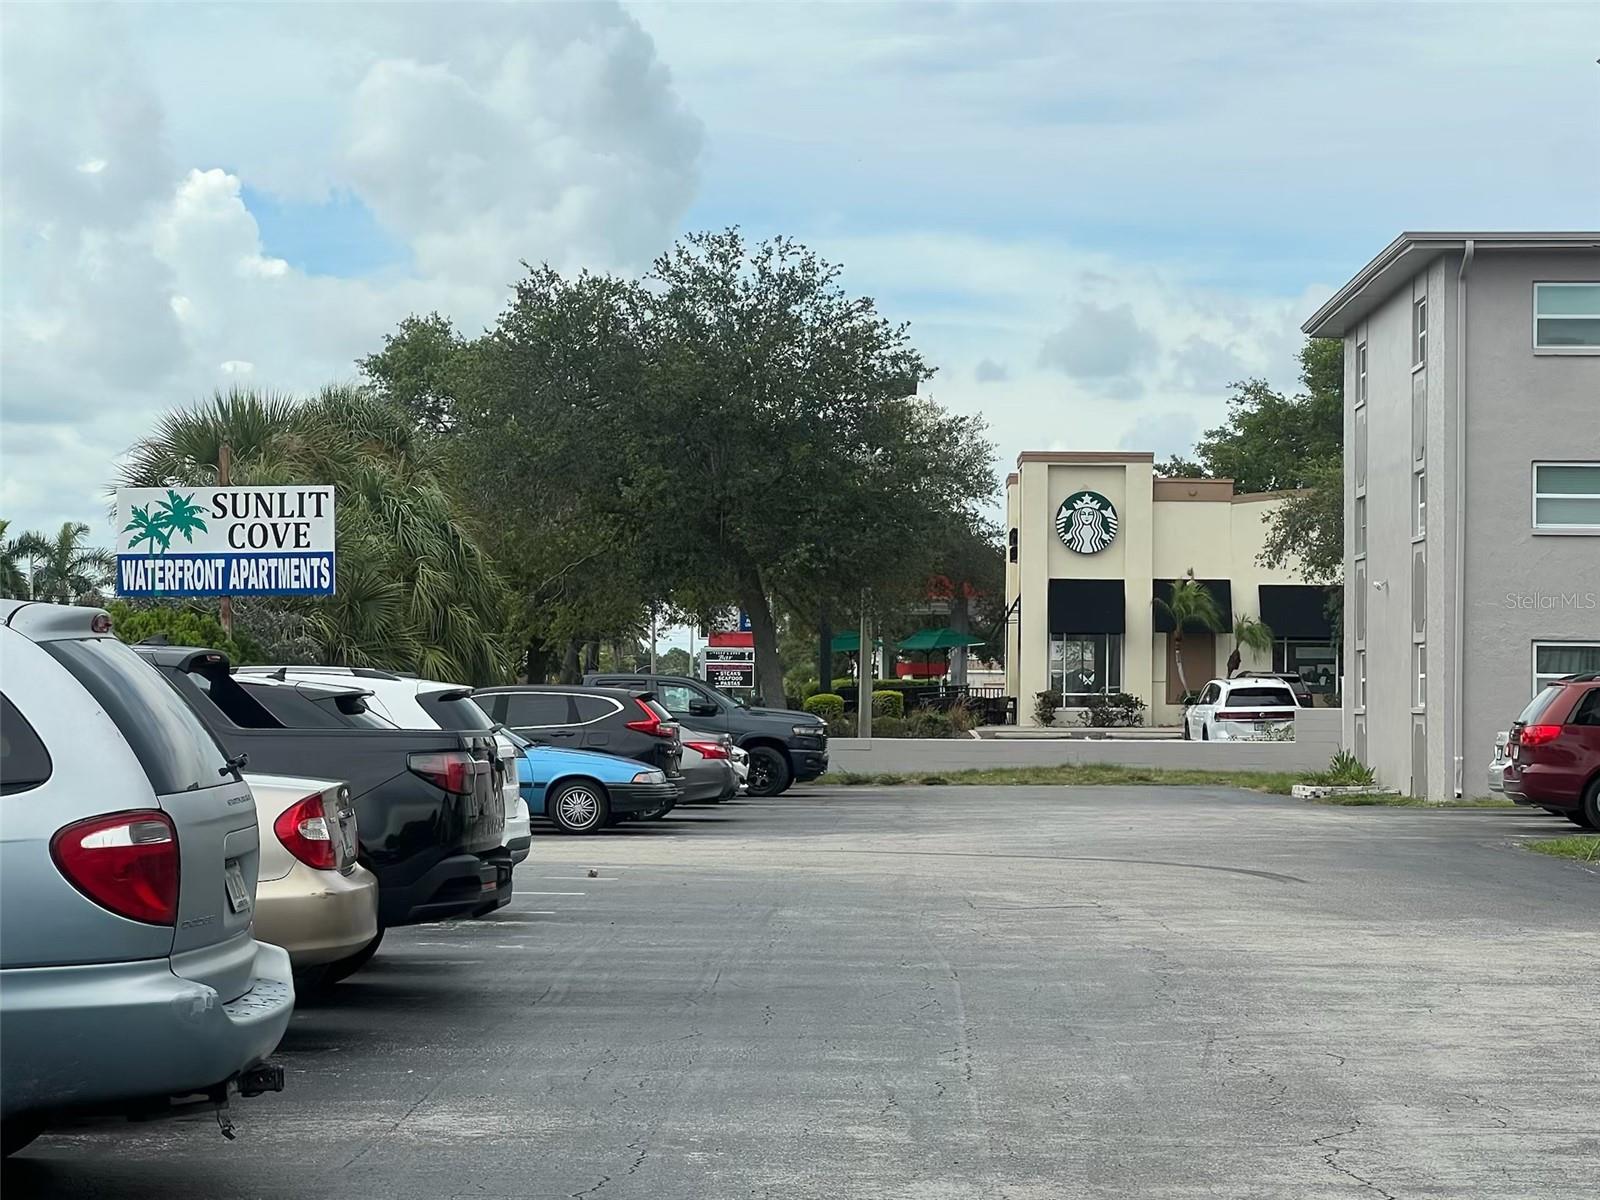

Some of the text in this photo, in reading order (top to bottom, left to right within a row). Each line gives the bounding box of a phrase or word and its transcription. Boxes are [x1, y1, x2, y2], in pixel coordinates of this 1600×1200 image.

[211, 491, 329, 519] SUNLIT
[228, 522, 311, 549] COVE
[121, 556, 331, 591] WATERFRONT APARTMENTS
